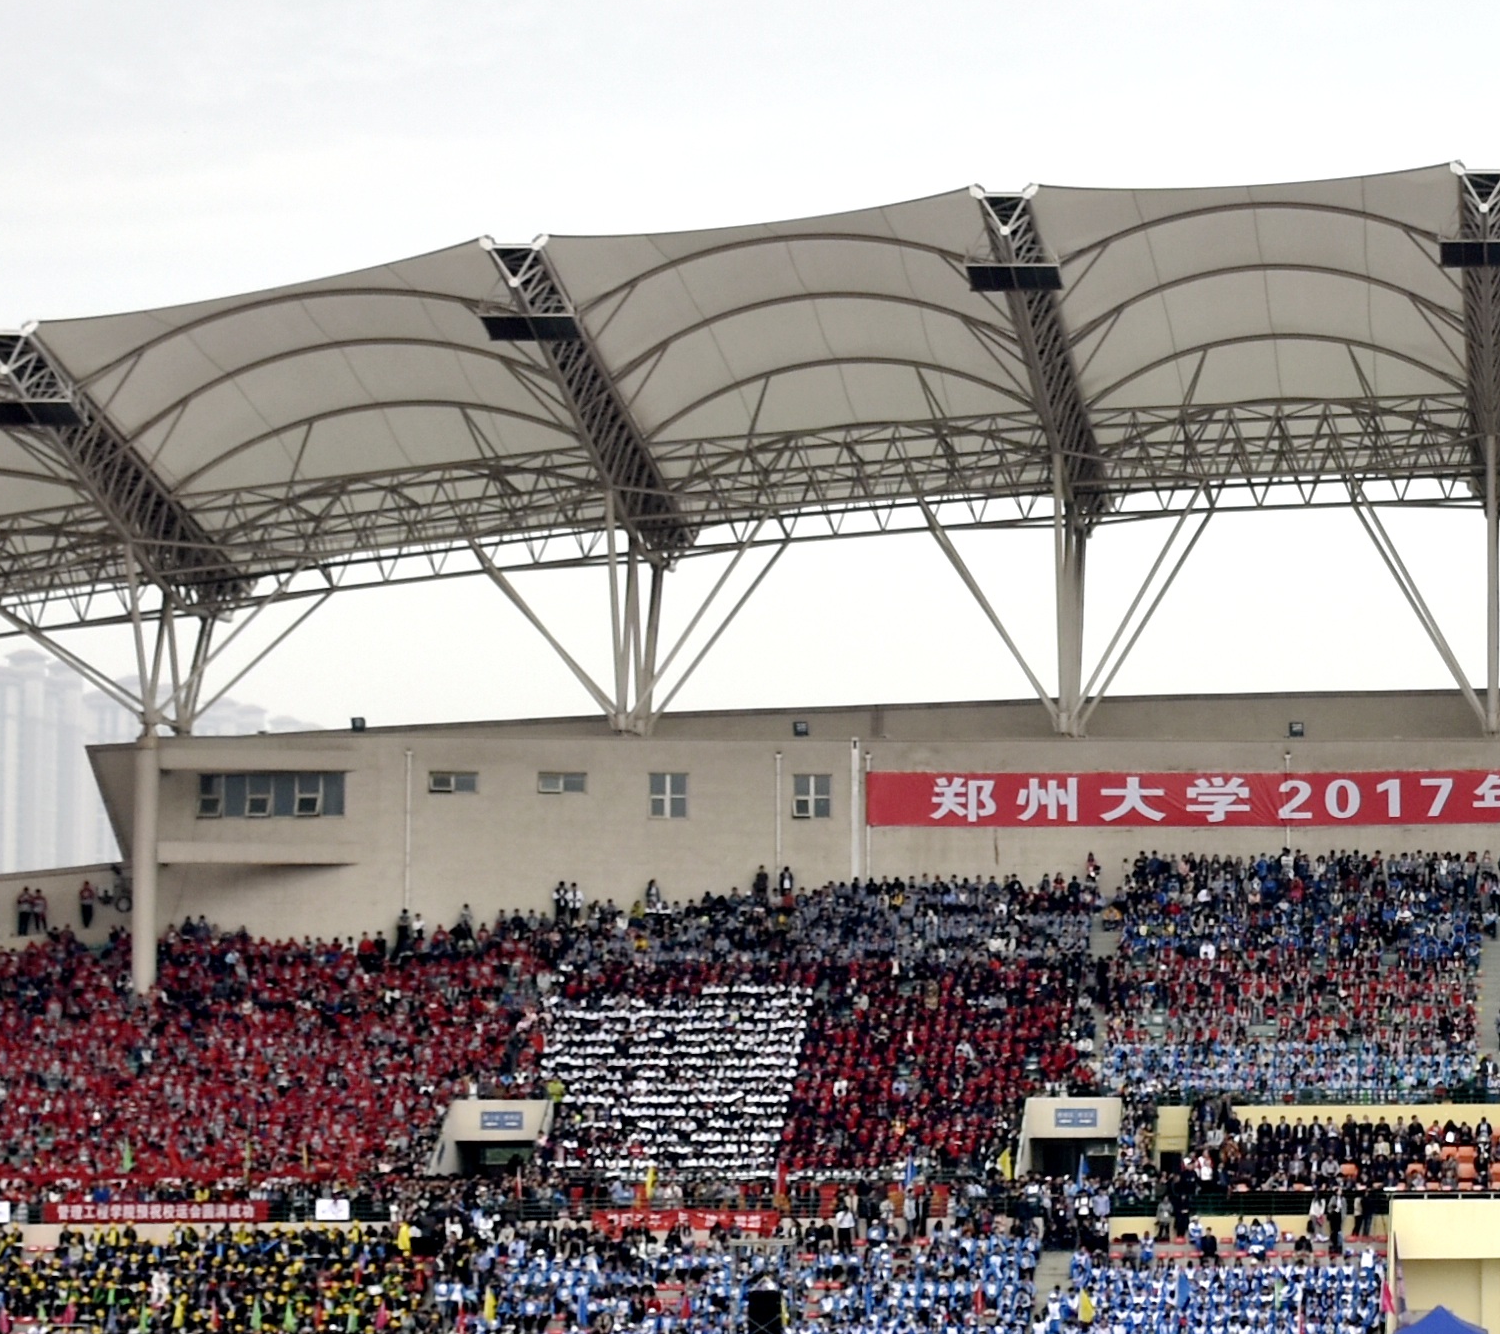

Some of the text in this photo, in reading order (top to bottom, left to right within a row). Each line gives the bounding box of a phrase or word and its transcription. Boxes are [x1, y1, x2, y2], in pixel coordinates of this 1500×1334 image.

[57, 1203, 255, 1220] 管理工程学院预祝校运会圆满成功
